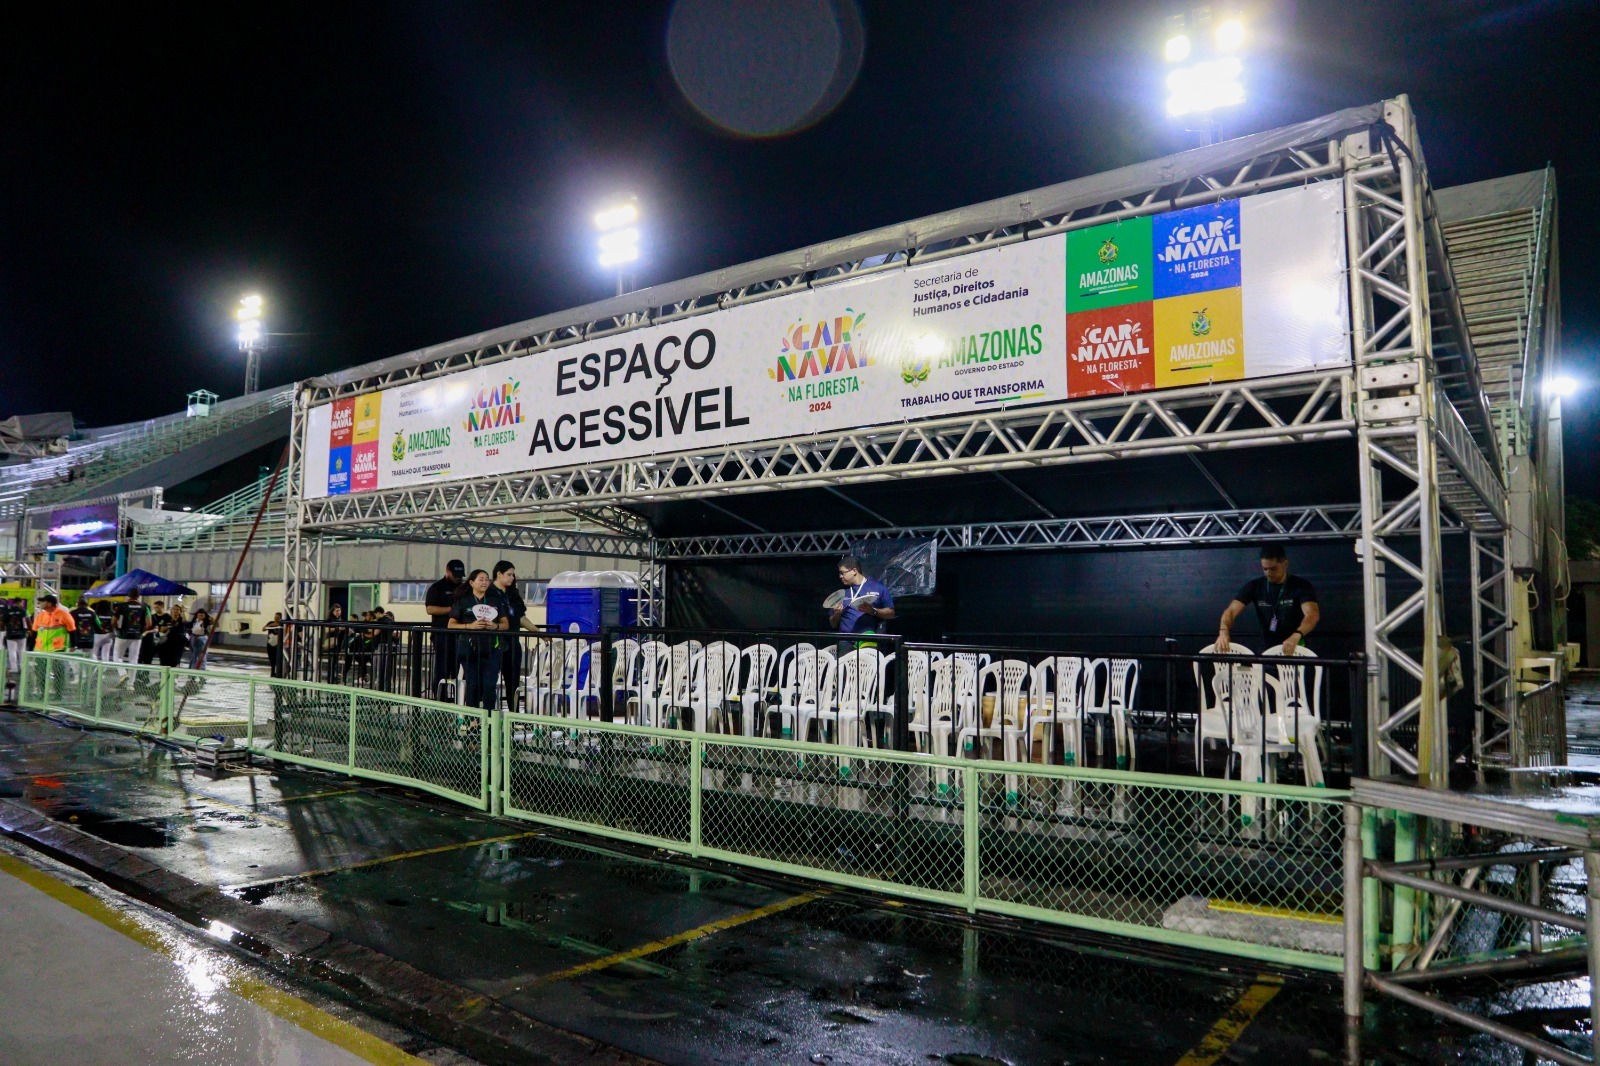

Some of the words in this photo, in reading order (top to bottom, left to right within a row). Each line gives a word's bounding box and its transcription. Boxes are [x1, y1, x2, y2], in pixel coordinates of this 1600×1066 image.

[1177, 221, 1224, 243] CAR
[1165, 234, 1241, 262] NAVAL
[1079, 264, 1139, 289] AMAZONAS
[1174, 263, 1186, 274] NA
[1188, 255, 1230, 271] FLORESTA
[1191, 271, 1209, 279] 2024
[913, 271, 962, 289] Secretaria
[965, 267, 979, 277] de
[913, 289, 951, 303] Justiça,
[953, 280, 995, 295] Direitos
[913, 302, 962, 317] Humanos
[964, 299, 971, 307] e
[973, 287, 1029, 306] Cidadania
[792, 316, 853, 351] CAR
[1089, 324, 1132, 344] CAR
[556, 328, 717, 396] ESPAÇO
[777, 342, 876, 382] NAVAL
[1078, 338, 1150, 363] NAVAL
[1170, 338, 1236, 363] AMAZONAS
[955, 366, 986, 376] GOVERNO
[999, 360, 1025, 370] ESTADO
[1087, 364, 1098, 375] NA
[1100, 358, 1138, 373] FLORESTA
[477, 383, 512, 408] CAR
[788, 386, 803, 402] NA
[806, 376, 859, 399] FLORESTA
[901, 393, 950, 407] TRABALHO
[952, 389, 972, 399] QUE
[974, 379, 1045, 397] TRANSFORMA
[468, 402, 525, 432] NAVAL
[809, 401, 832, 413] 2024
[528, 384, 750, 456] ACESSÍVEL
[408, 427, 451, 453] AMAZONAS
[474, 436, 483, 448] NA
[484, 430, 516, 446] FLORESTA
[486, 448, 499, 456] 2024
[391, 468, 413, 477] TRABALHO
[422, 462, 451, 472] TRANSFORMA
